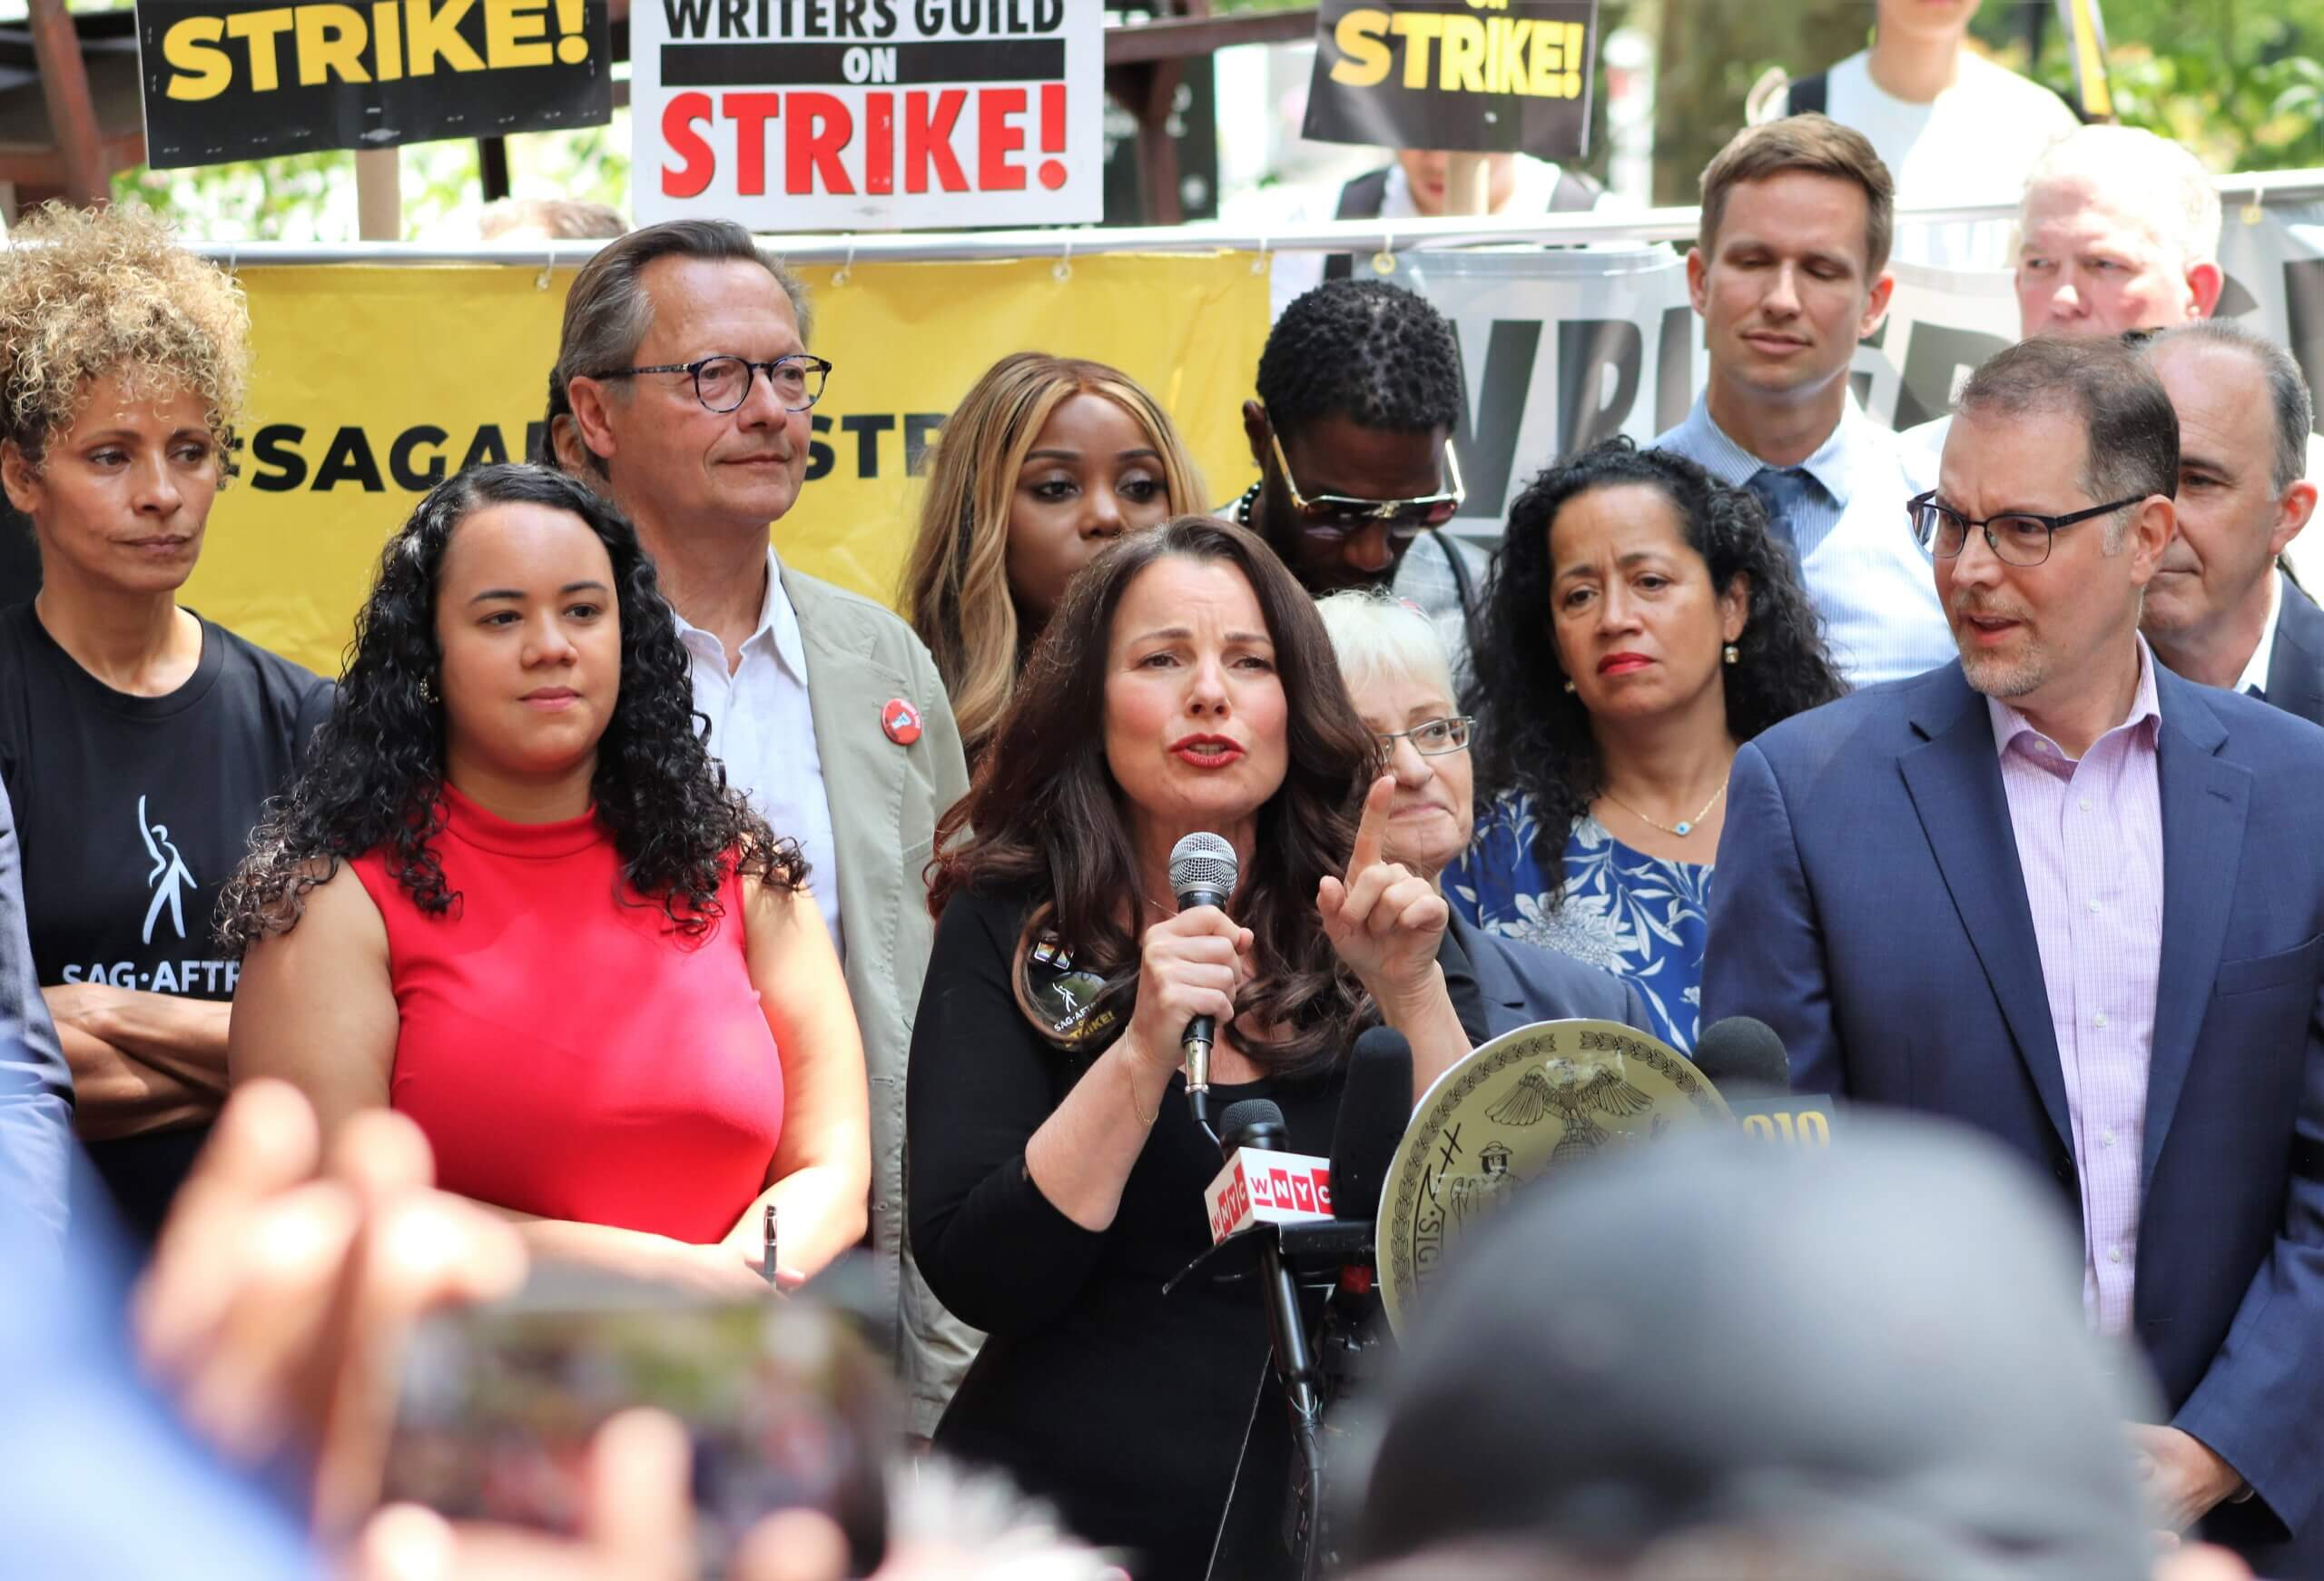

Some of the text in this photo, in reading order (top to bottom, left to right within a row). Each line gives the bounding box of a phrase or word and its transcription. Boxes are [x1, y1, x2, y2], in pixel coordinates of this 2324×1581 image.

[665, 0, 1065, 39] WRITERS GUILD
[162, 0, 590, 103] STRIKE!
[842, 46, 897, 84] ON
[1329, 9, 1584, 100] STRIKE!
[661, 84, 1068, 199] STRIKE!
[1211, 1180, 1246, 1235] WNYC
[1250, 1176, 1332, 1204] WNYC
